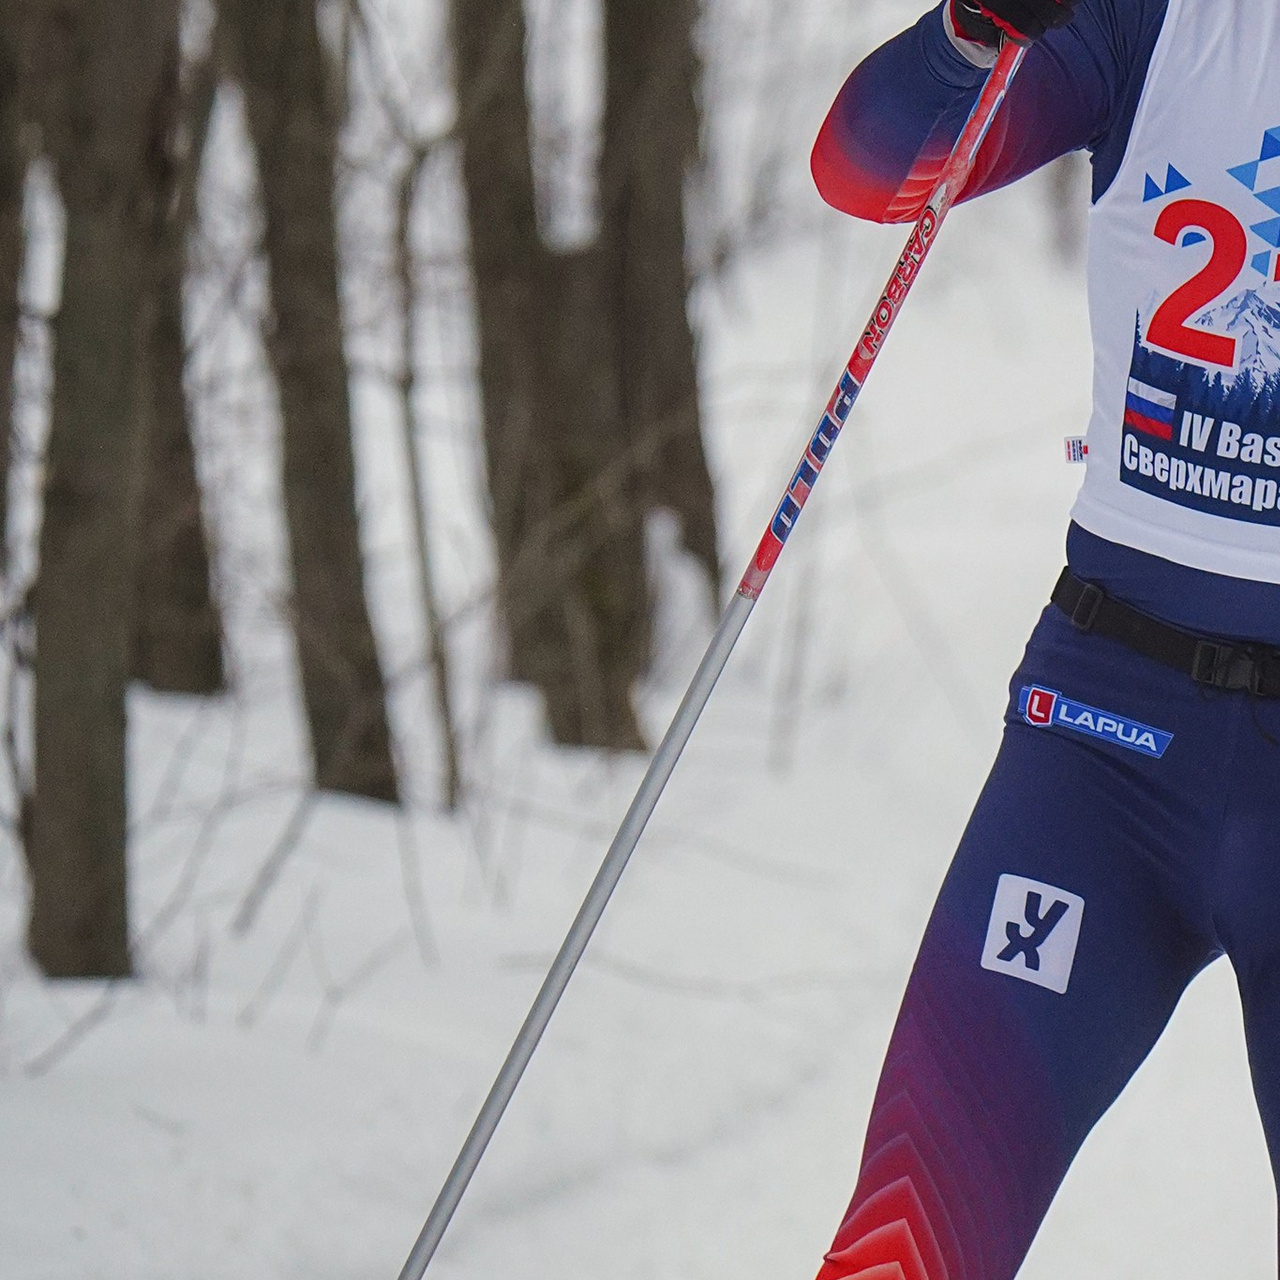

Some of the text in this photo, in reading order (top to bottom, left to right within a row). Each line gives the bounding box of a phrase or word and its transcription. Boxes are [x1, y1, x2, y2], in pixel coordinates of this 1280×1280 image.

[862, 206, 938, 356] CARBON
[1178, 411, 1215, 452] IV
[1058, 704, 1157, 752] LAPUA
